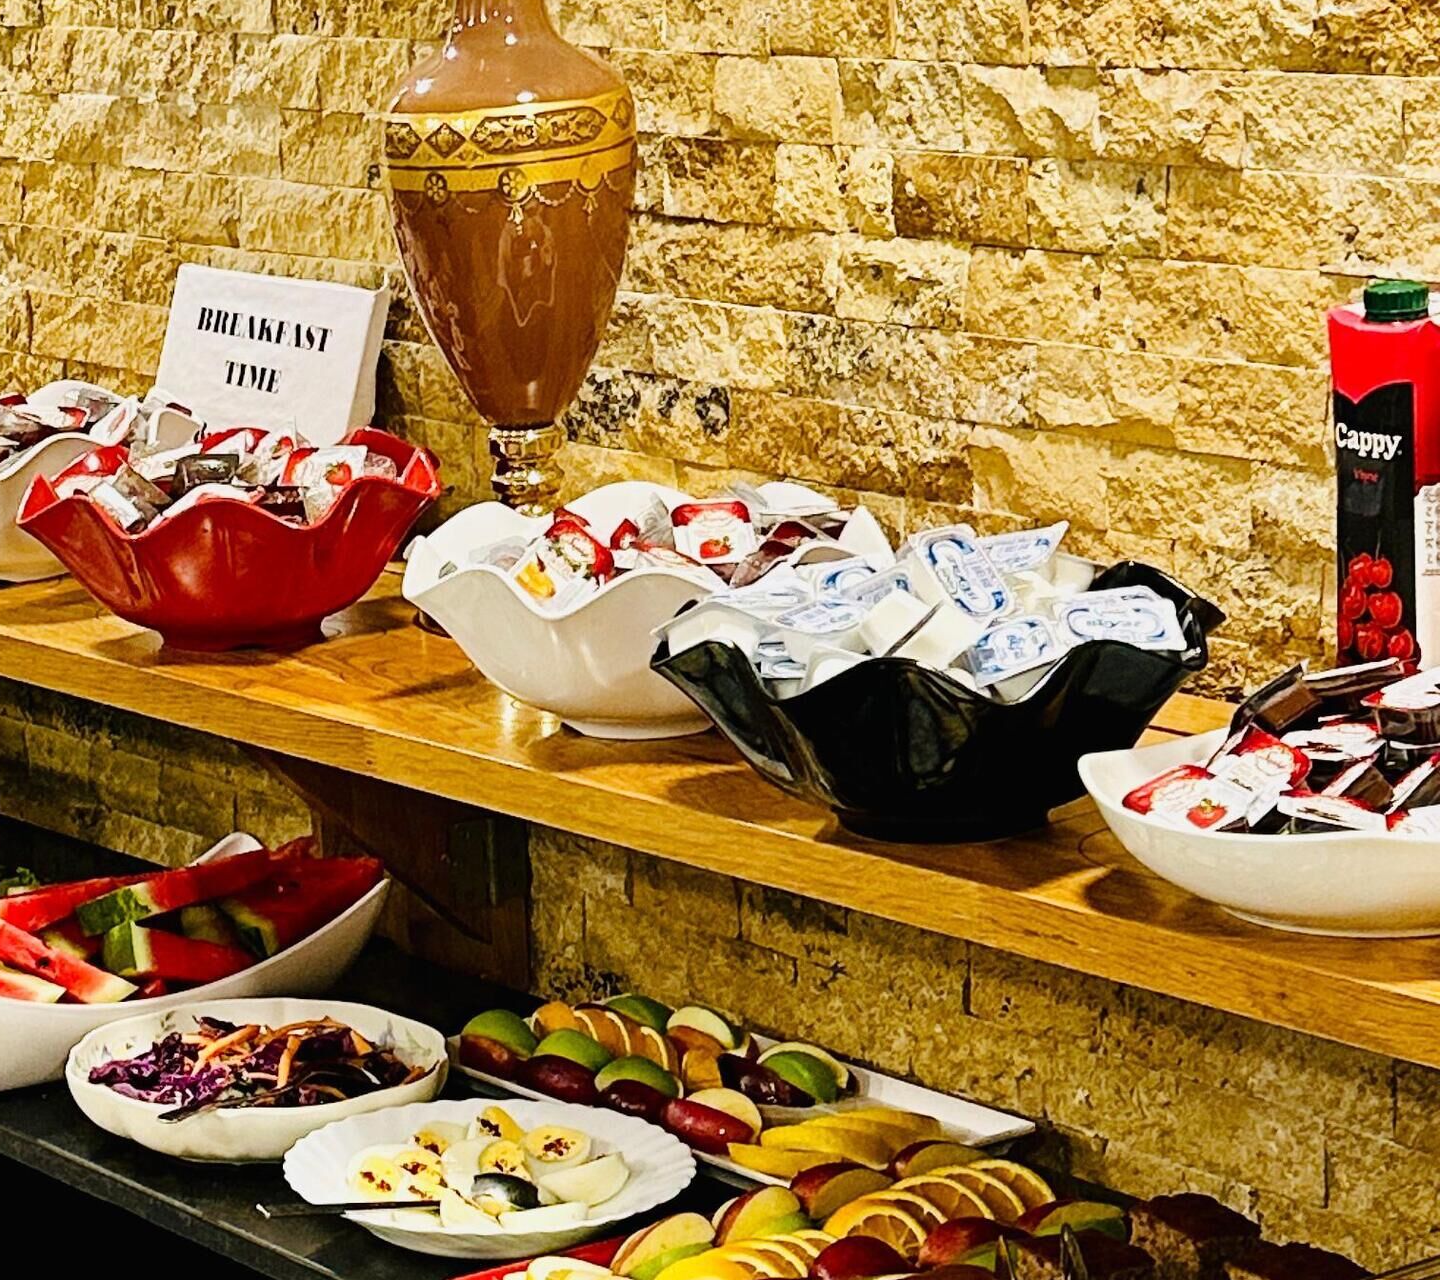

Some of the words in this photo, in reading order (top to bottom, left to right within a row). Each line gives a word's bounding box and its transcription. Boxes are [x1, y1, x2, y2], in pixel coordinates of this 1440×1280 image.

[197, 306, 334, 353] BREAKFAST
[225, 359, 282, 395] TIME
[1335, 422, 1403, 461] Cappy
